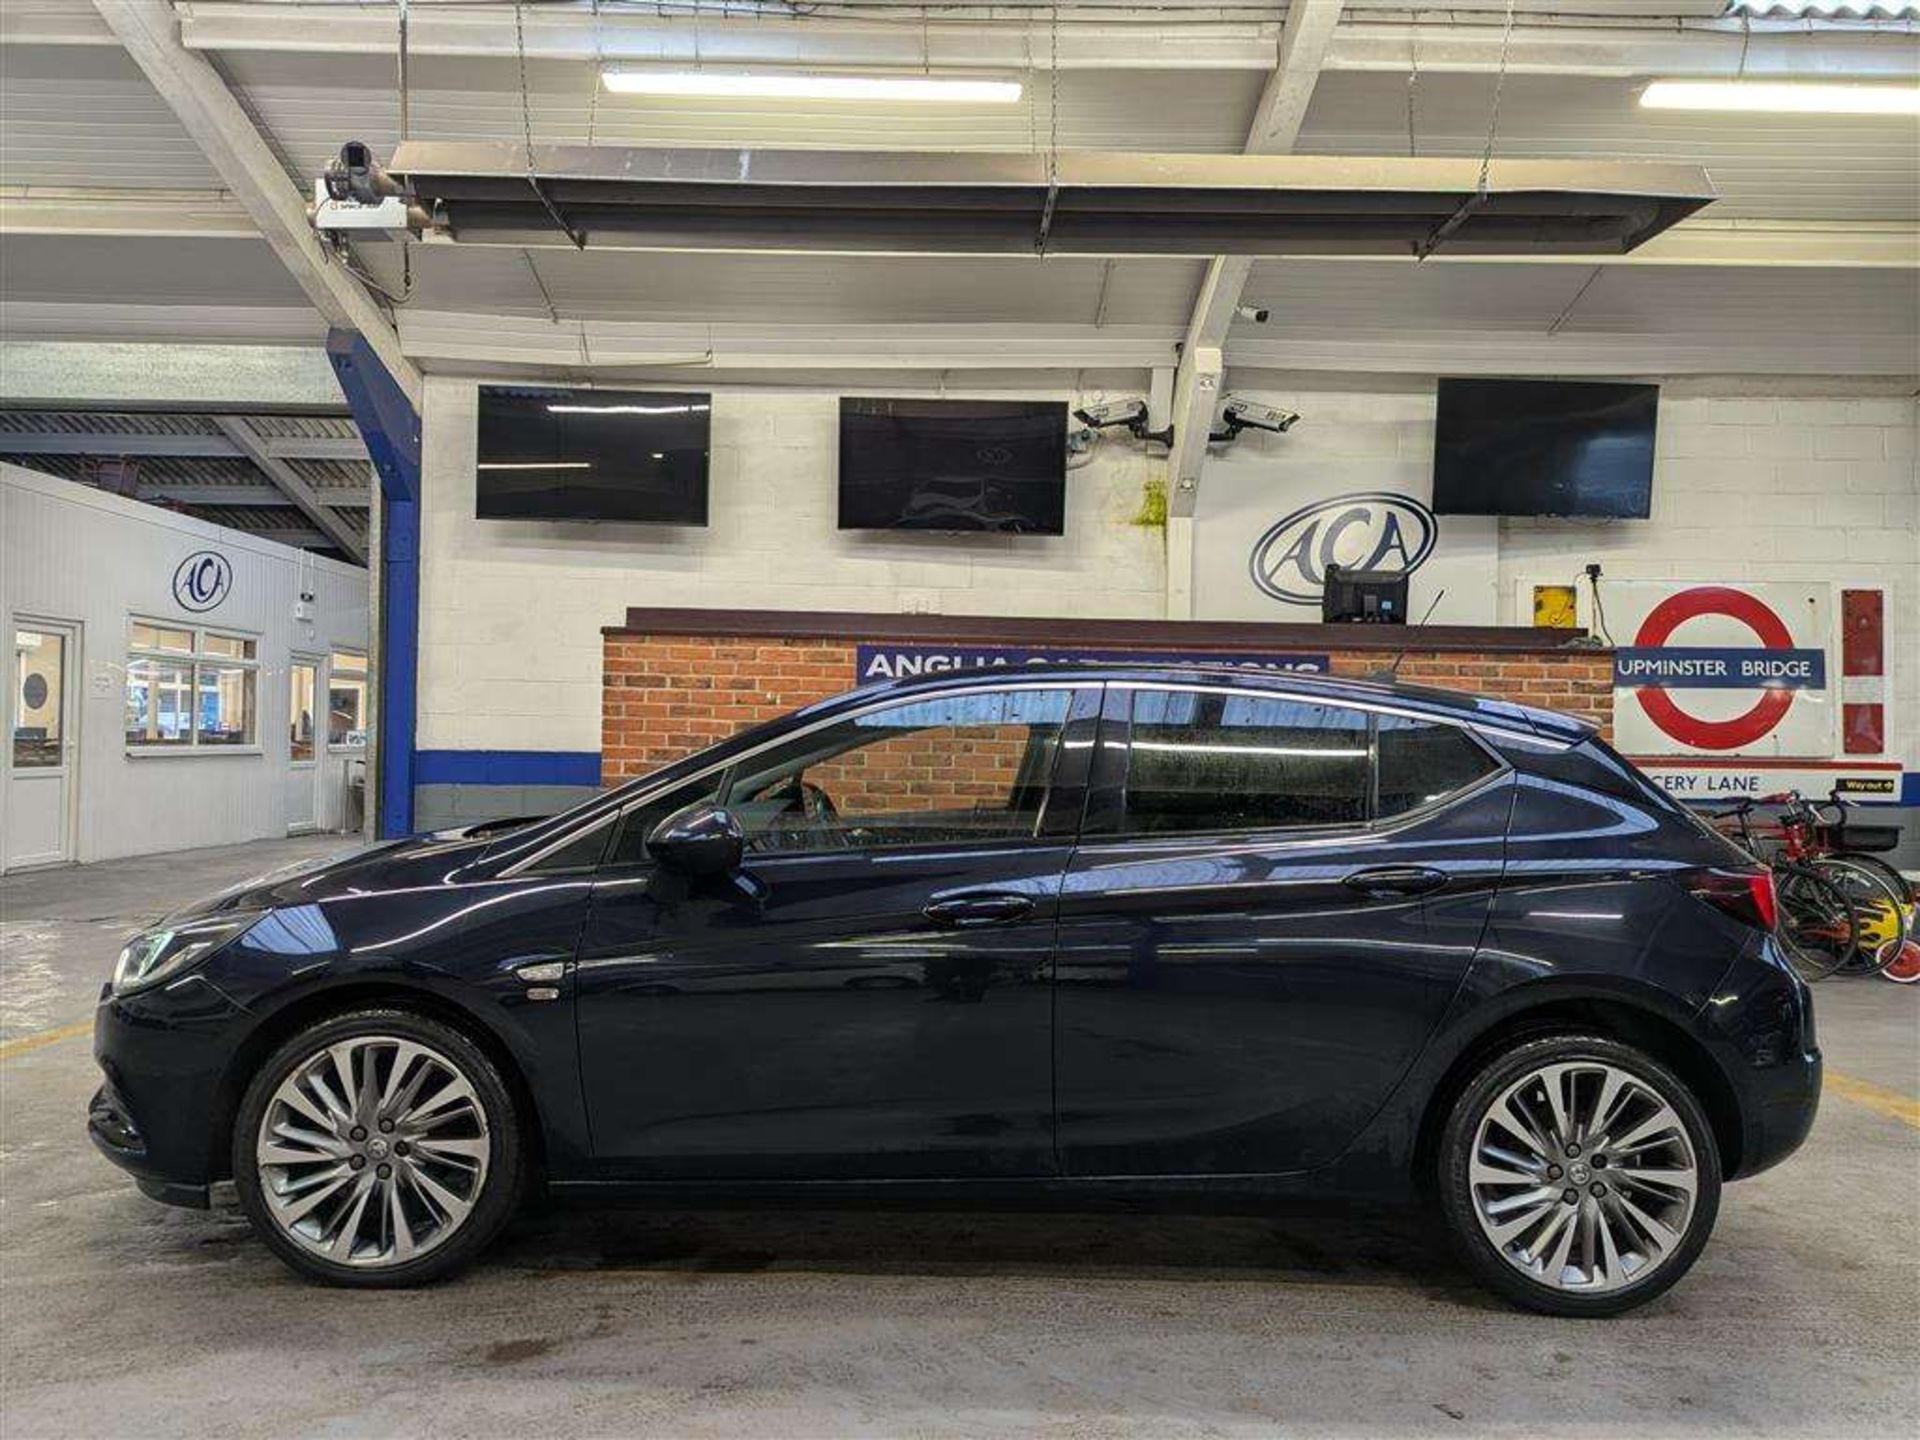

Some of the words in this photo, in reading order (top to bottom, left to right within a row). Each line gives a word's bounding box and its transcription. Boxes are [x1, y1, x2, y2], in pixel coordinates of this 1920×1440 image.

[1267, 507, 1408, 585] ACA
[177, 557, 224, 604] ACA
[1617, 659, 1728, 676] UPMINSTER
[1741, 660, 1812, 677] BRIDGE
[1707, 775, 1760, 791] LANE
